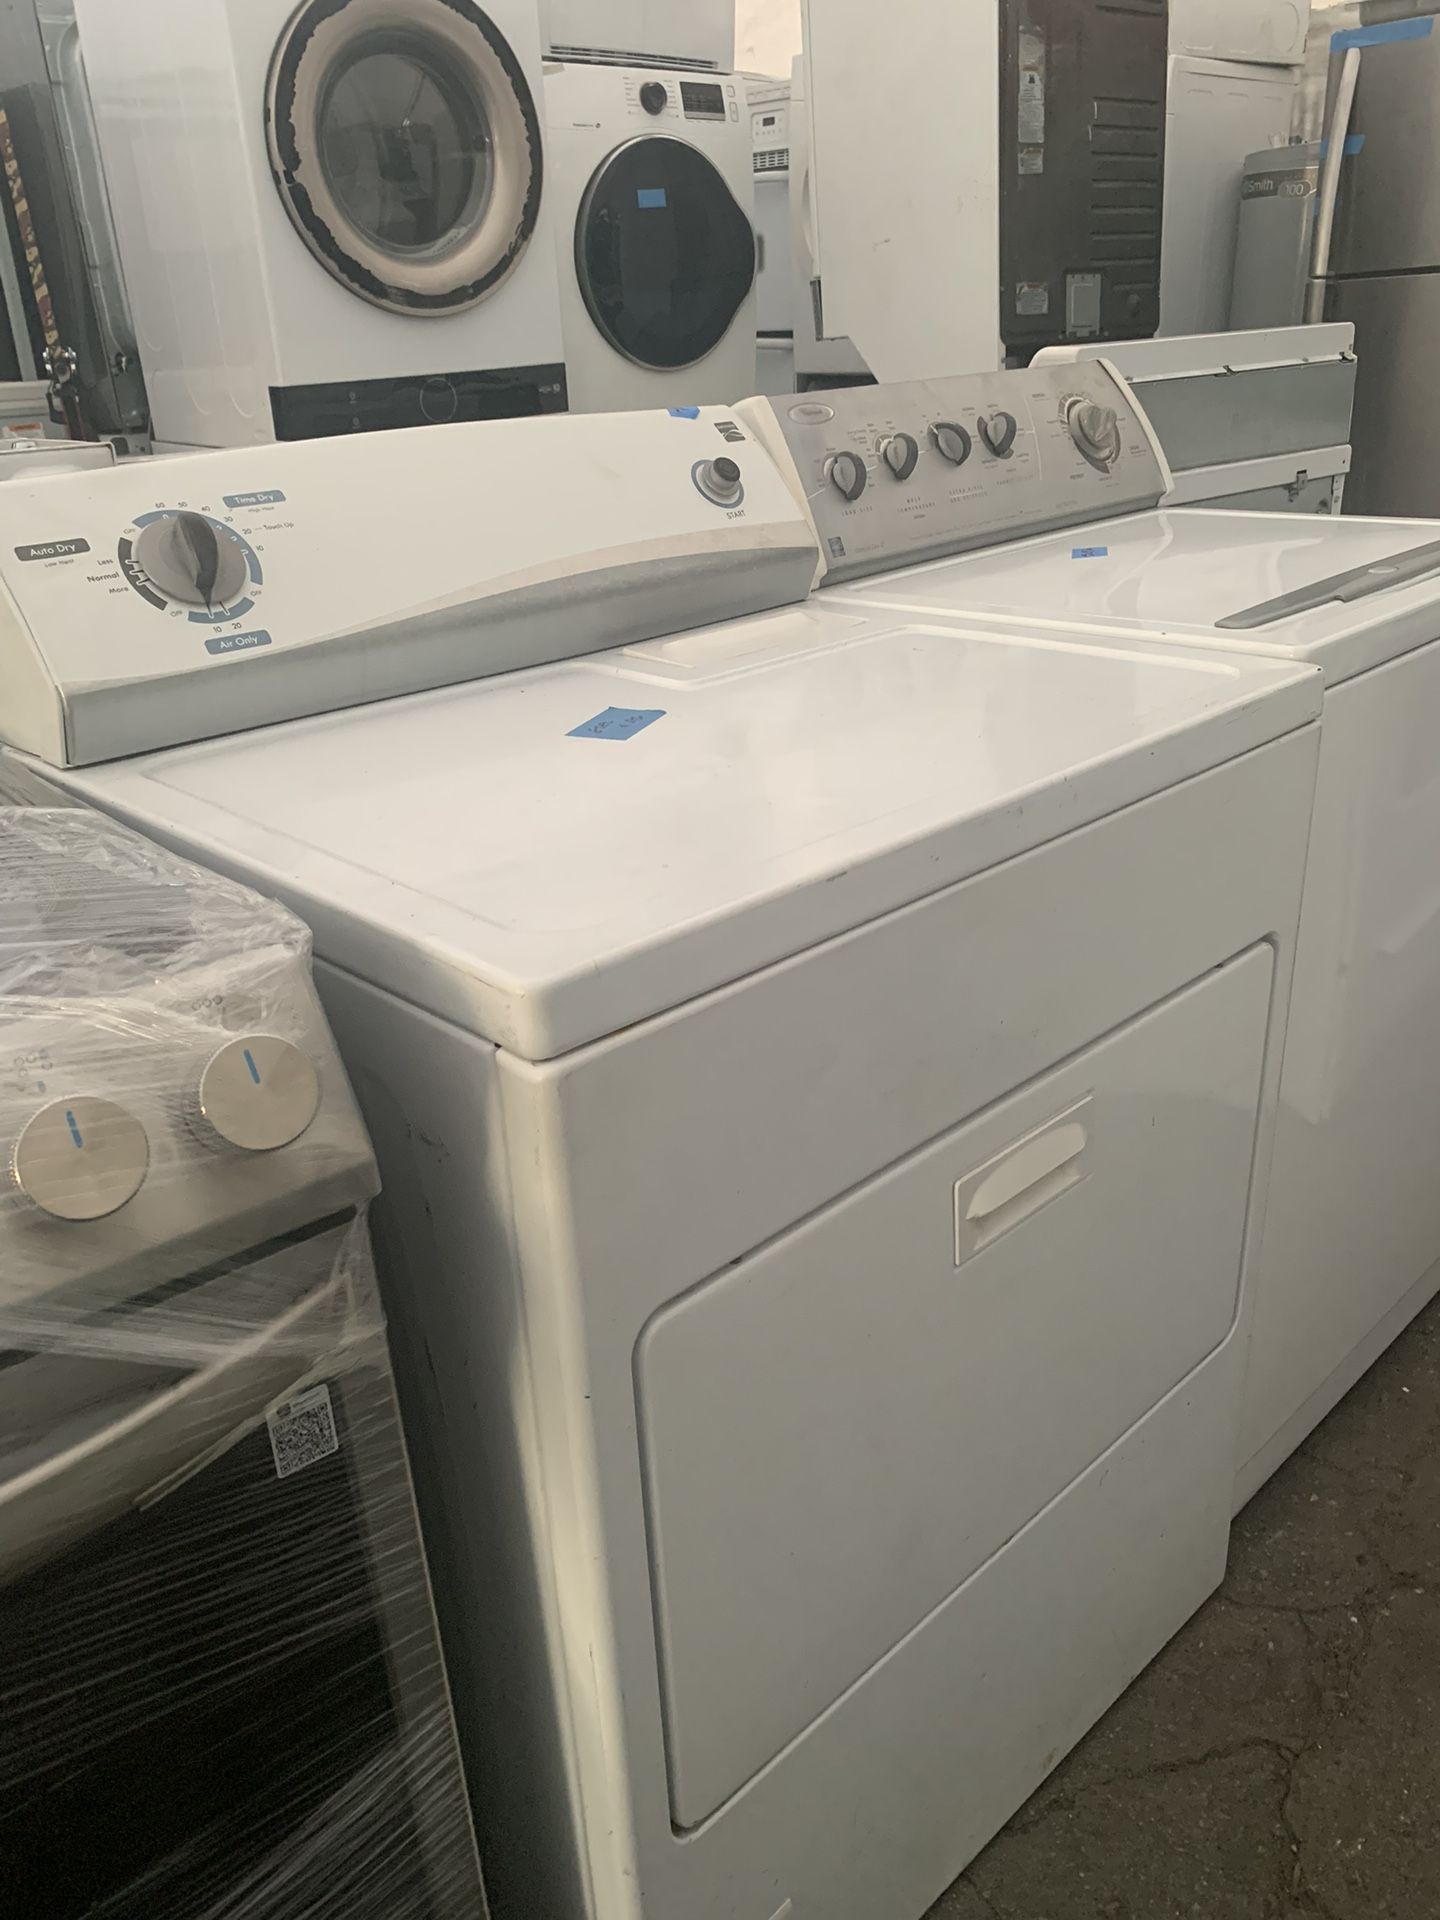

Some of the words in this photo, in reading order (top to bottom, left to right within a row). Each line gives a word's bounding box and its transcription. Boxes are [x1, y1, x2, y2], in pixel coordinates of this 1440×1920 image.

[1247, 179, 1273, 193] Smith
[234, 495, 256, 505] Time
[258, 493, 274, 503] Dry
[726, 509, 746, 520] START
[30, 547, 55, 557] Auto
[55, 543, 76, 553] Dry
[97, 558, 114, 566] Less
[86, 571, 120, 583] Normal
[108, 586, 129, 595] More
[213, 626, 222, 634] 10
[232, 622, 242, 630] 20
[219, 640, 233, 649] Air
[235, 635, 259, 647] Only
